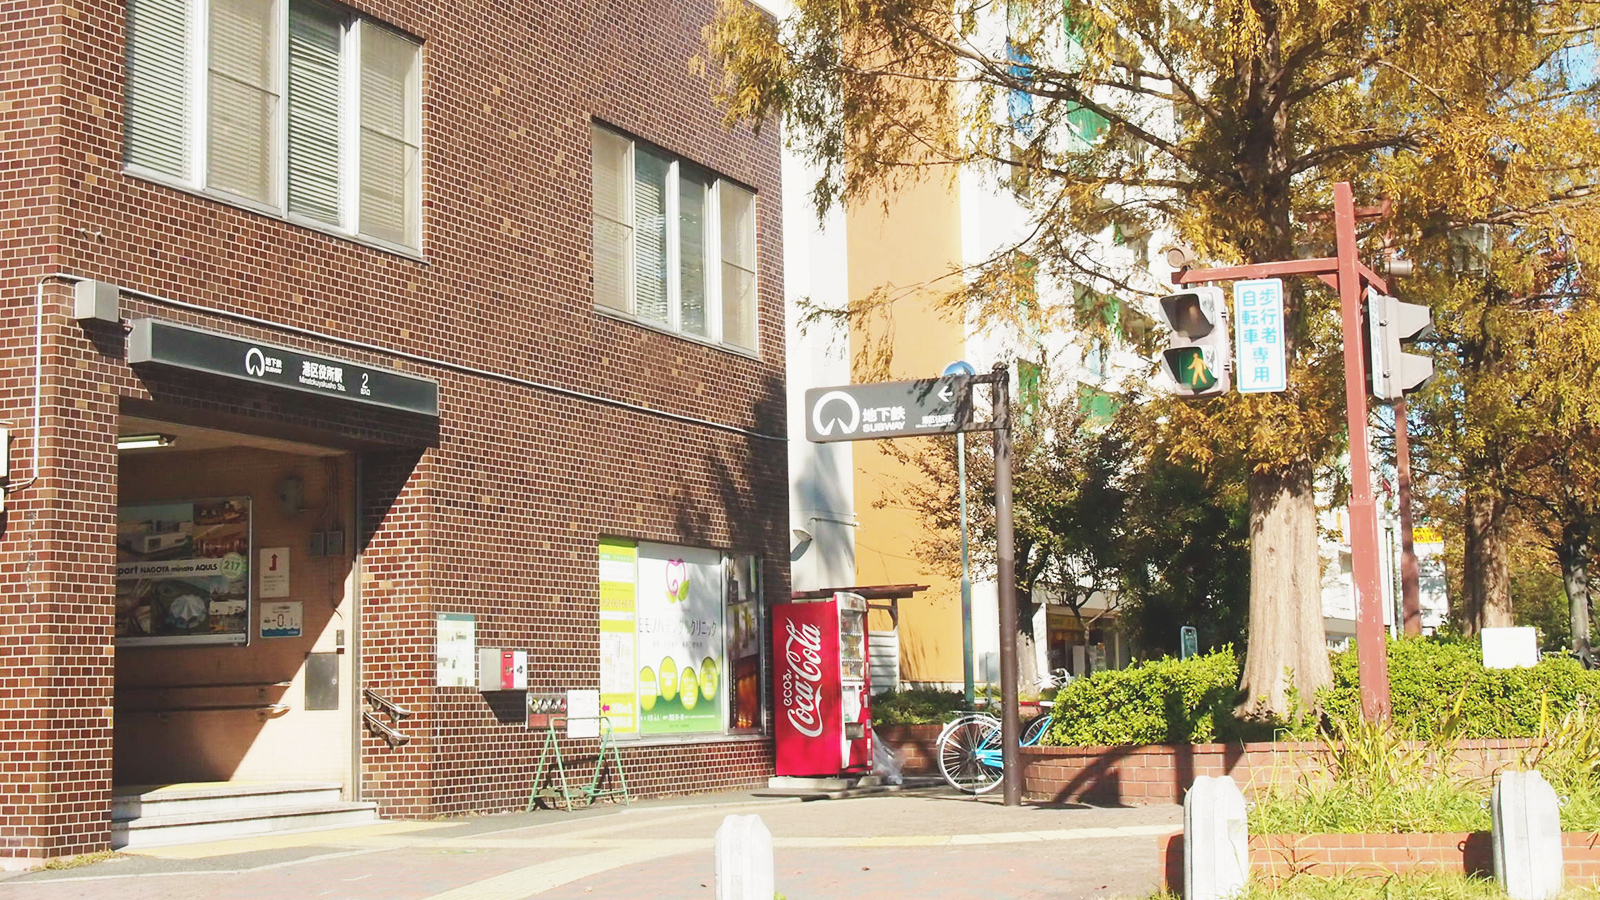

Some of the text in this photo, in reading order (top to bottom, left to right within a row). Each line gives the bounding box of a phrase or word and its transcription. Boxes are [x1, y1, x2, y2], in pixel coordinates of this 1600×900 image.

[1242, 290, 1259, 344] 自転車
[1259, 288, 1276, 344] 歩行者
[265, 357, 281, 367] 地下鉄
[1252, 346, 1269, 382] 専用
[302, 361, 342, 383] 港区役所駅
[361, 373, 369, 389] 2
[862, 406, 905, 422] 地下鉄
[862, 421, 905, 432] SUBWAY
[140, 565, 170, 574] NAGOYA
[170, 564, 194, 572] minato
[195, 563, 218, 571] AQULS
[223, 560, 241, 571] 217
